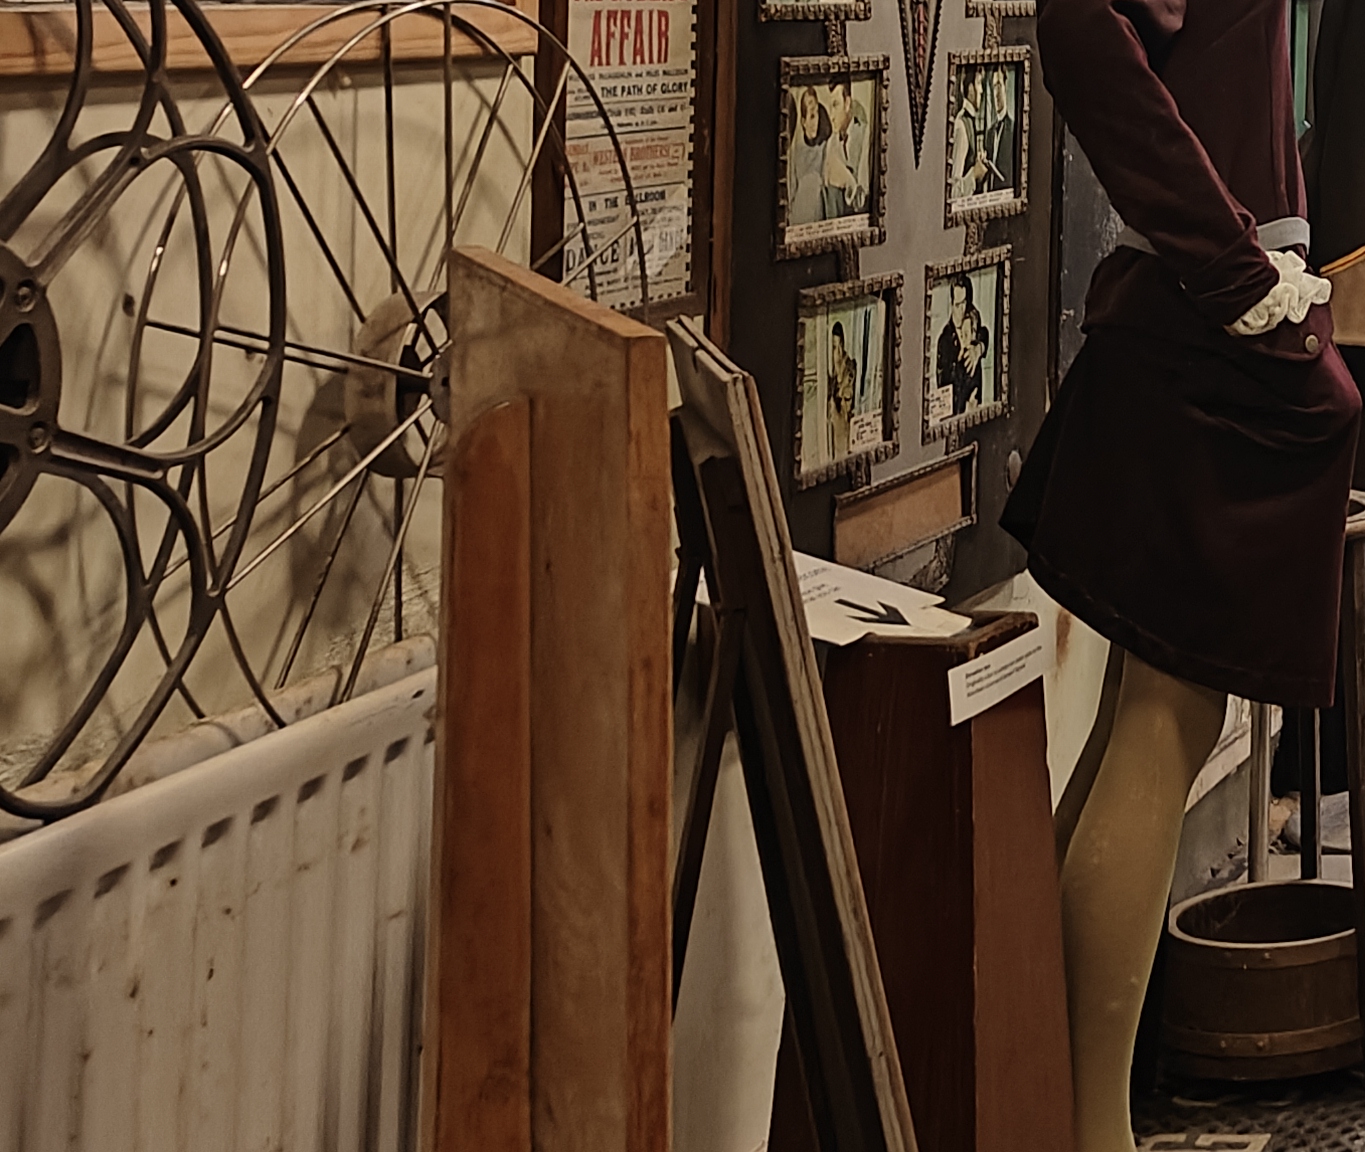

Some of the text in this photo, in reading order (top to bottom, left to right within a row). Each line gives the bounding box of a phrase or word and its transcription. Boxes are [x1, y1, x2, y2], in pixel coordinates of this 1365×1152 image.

[589, 8, 670, 67] AFFAIR
[600, 81, 689, 98] THE PATH OF GLORY
[604, 195, 619, 209] THE
